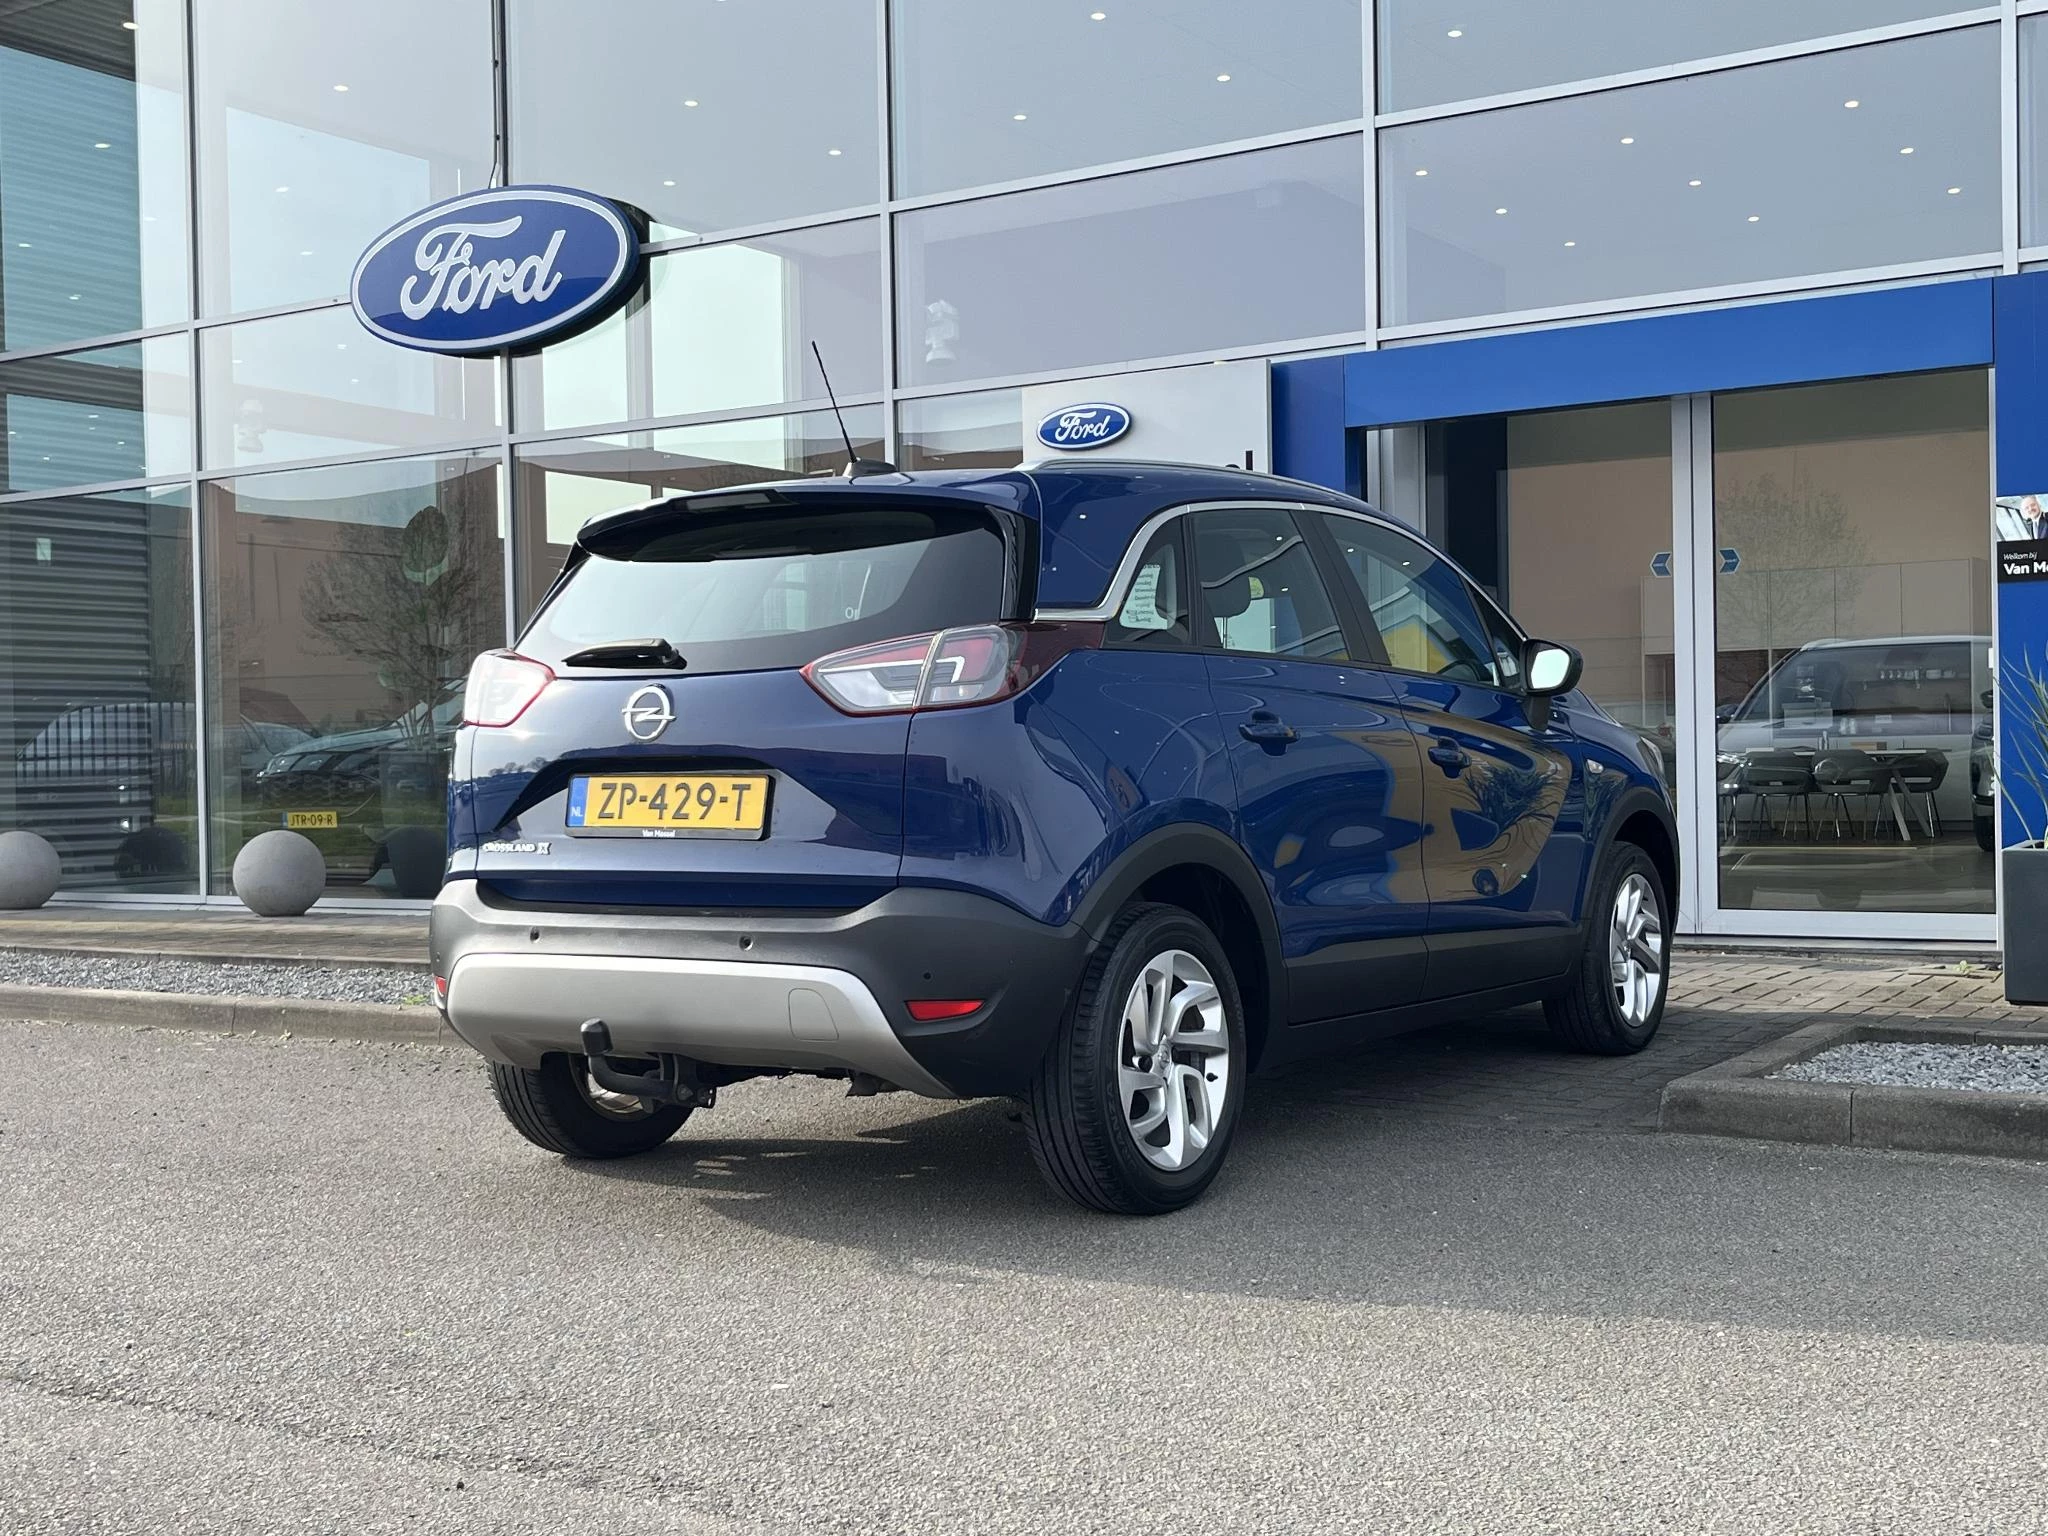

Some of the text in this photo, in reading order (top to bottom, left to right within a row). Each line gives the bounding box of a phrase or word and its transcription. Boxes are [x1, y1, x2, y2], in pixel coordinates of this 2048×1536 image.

[400, 215, 567, 321] Ford
[1054, 411, 1111, 442] Ford
[2003, 551, 2038, 560] Welkom bij
[2003, 562, 2030, 575] Van
[598, 782, 751, 821] ZP-429-T
[571, 806, 584, 817] NL
[290, 814, 333, 826] JTR-09-R
[483, 841, 536, 853] CROSSLAND
